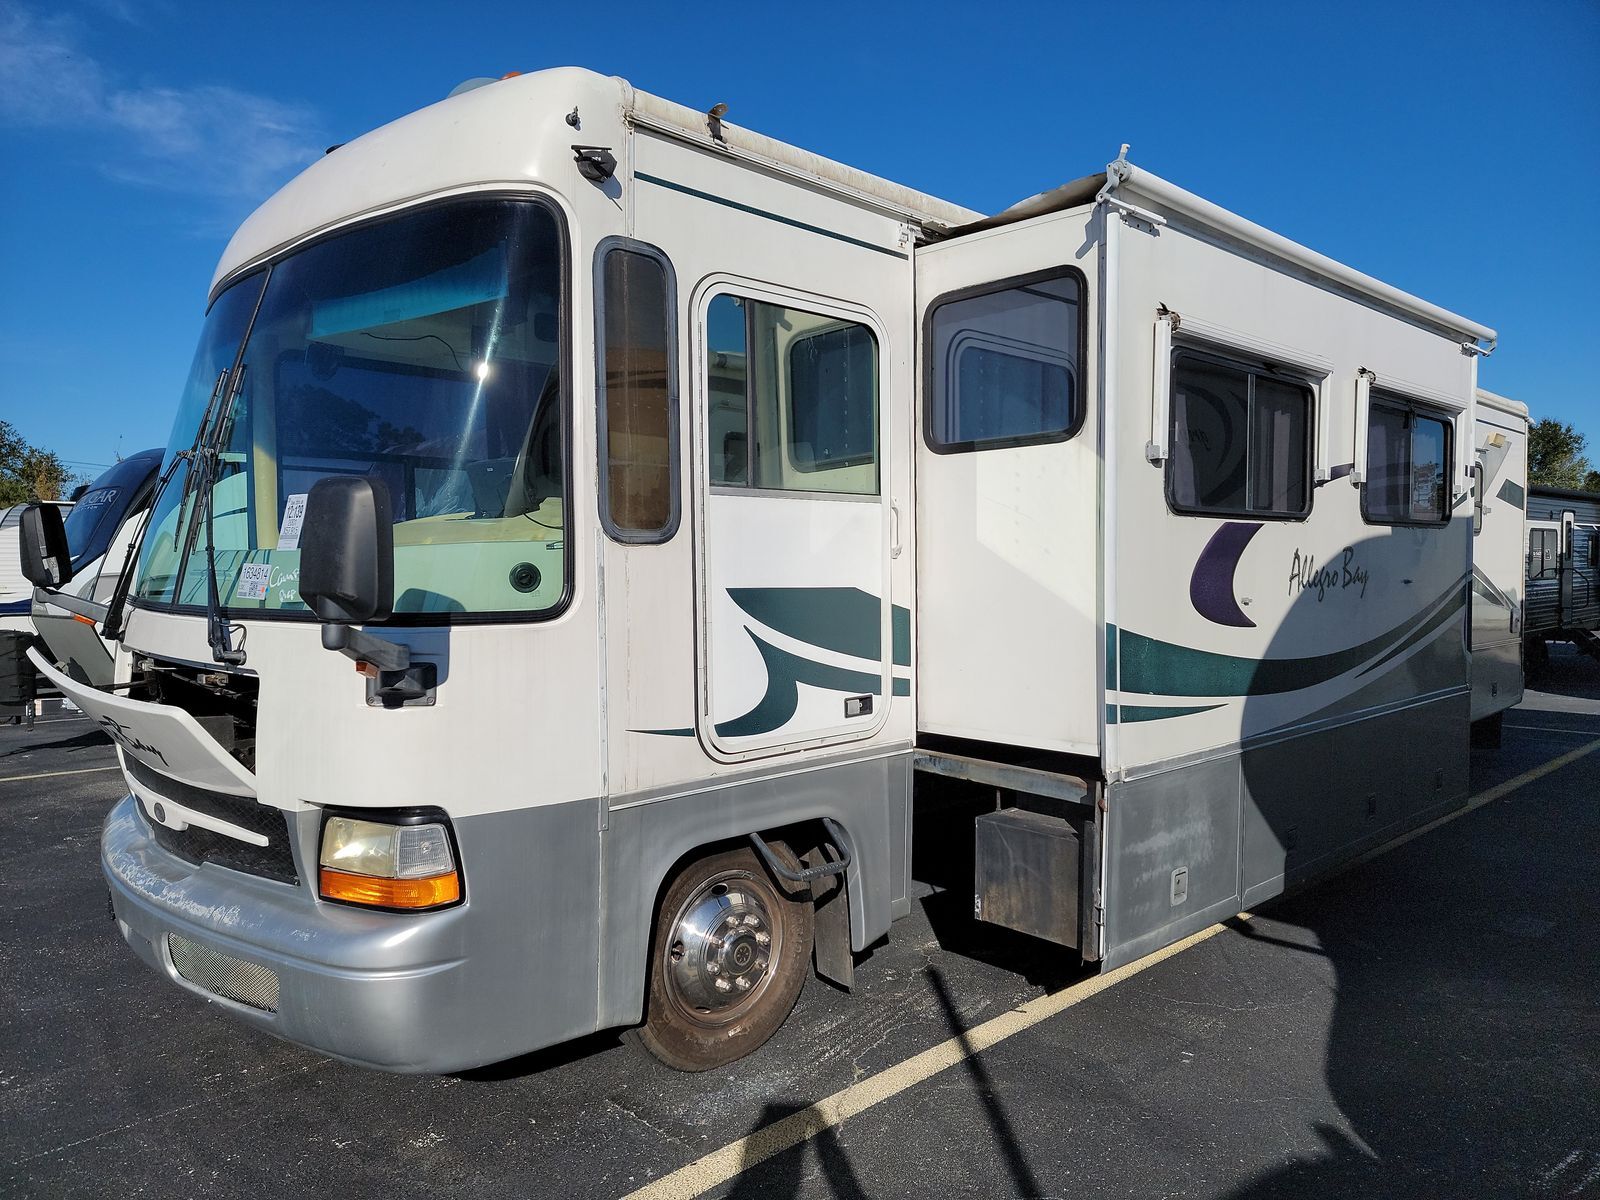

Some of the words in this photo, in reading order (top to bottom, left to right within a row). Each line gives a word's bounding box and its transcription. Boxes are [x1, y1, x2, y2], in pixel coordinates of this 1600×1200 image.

[243, 566, 269, 580] 1634814
[1288, 547, 1339, 602] Allegro
[1341, 546, 1370, 599] Bay
